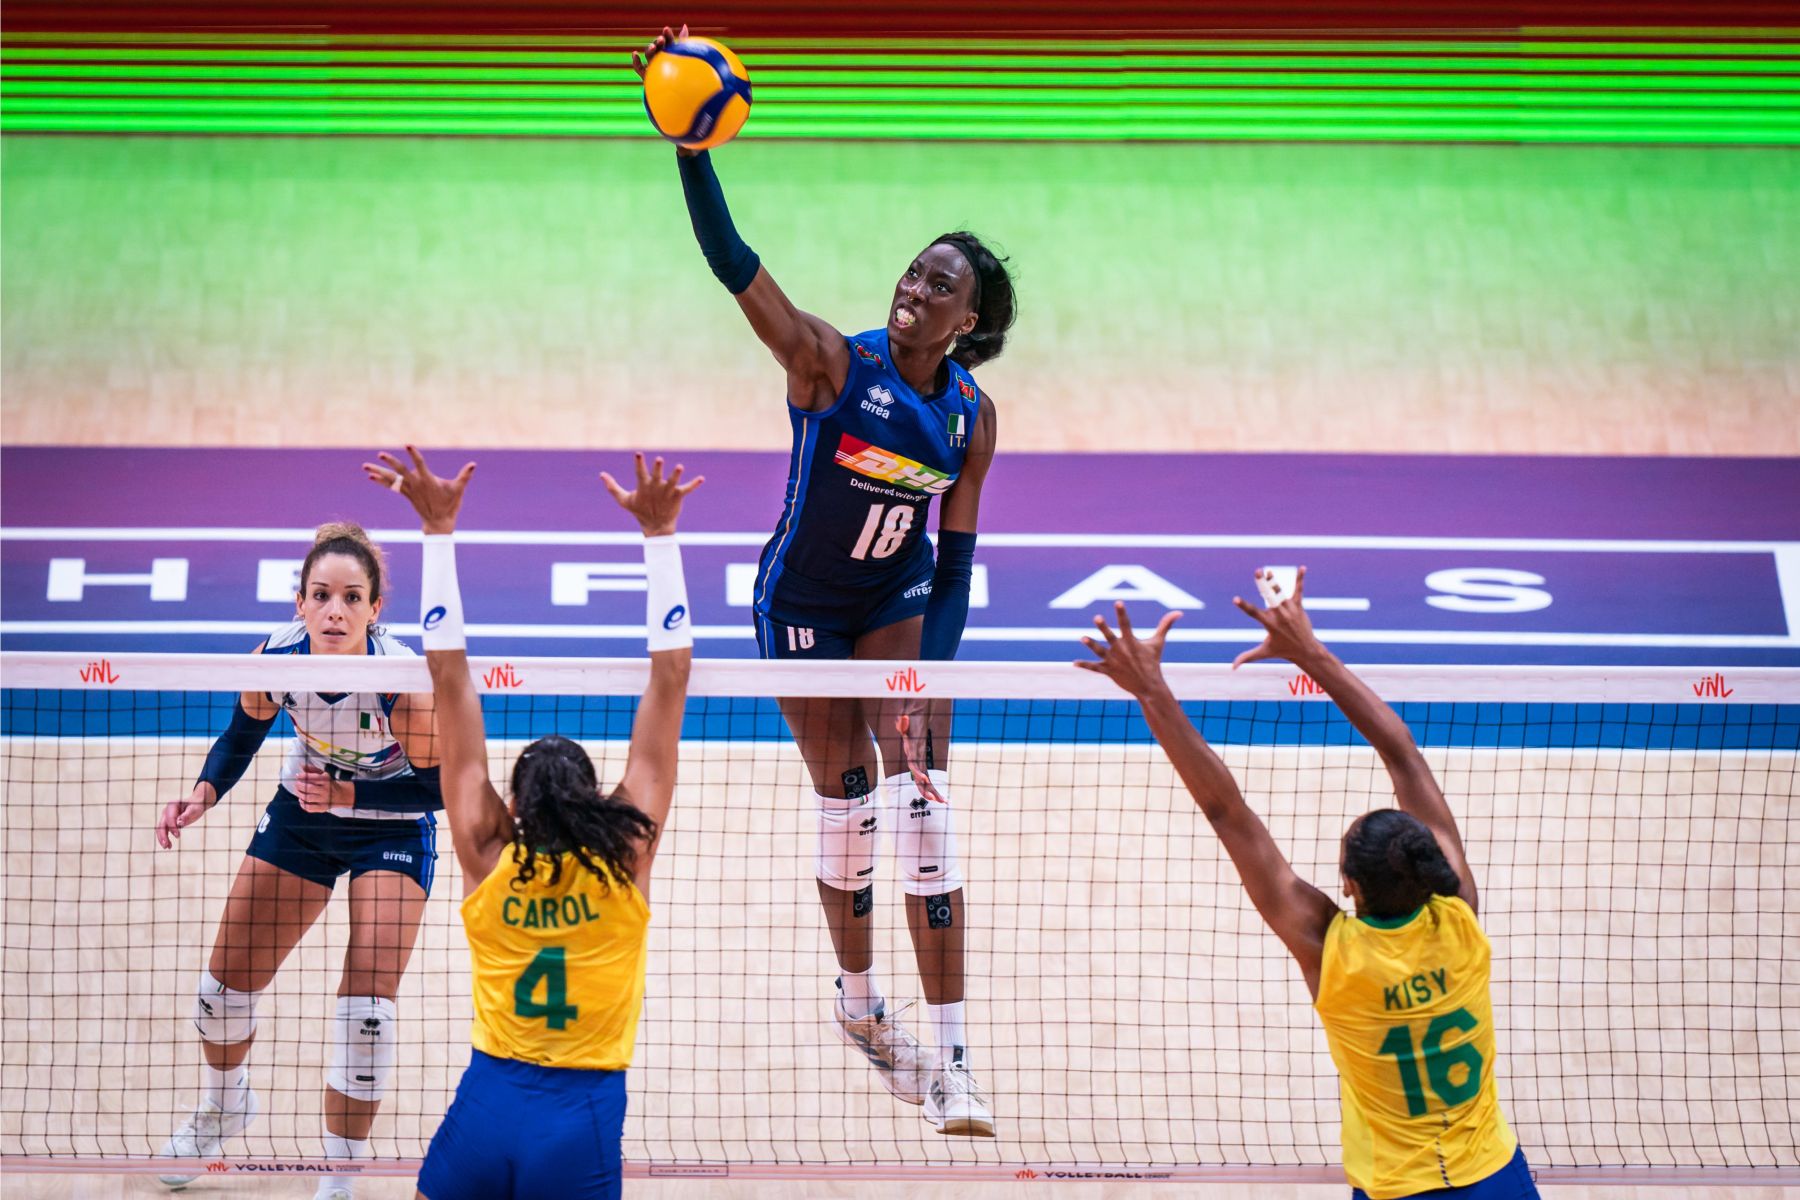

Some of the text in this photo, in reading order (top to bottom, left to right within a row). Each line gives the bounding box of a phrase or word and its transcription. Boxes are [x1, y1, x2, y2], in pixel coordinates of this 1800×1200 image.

[860, 400, 890, 420] errea
[850, 477, 895, 496] Delivered
[850, 503, 915, 560] 18
[551, 562, 1553, 613] FIALS
[787, 626, 815, 651] 18
[80, 659, 120, 685] VNL
[483, 663, 524, 689] VNL
[886, 667, 926, 693] VNL
[1693, 673, 1734, 699] VNL
[910, 810, 931, 819] errea
[382, 851, 413, 863] errea
[502, 893, 600, 929] CAROL
[514, 946, 578, 1031] 4
[1383, 967, 1448, 1011] KISY
[1378, 1007, 1484, 1118] 16
[235, 1163, 334, 1172] VOLLEYBALL
